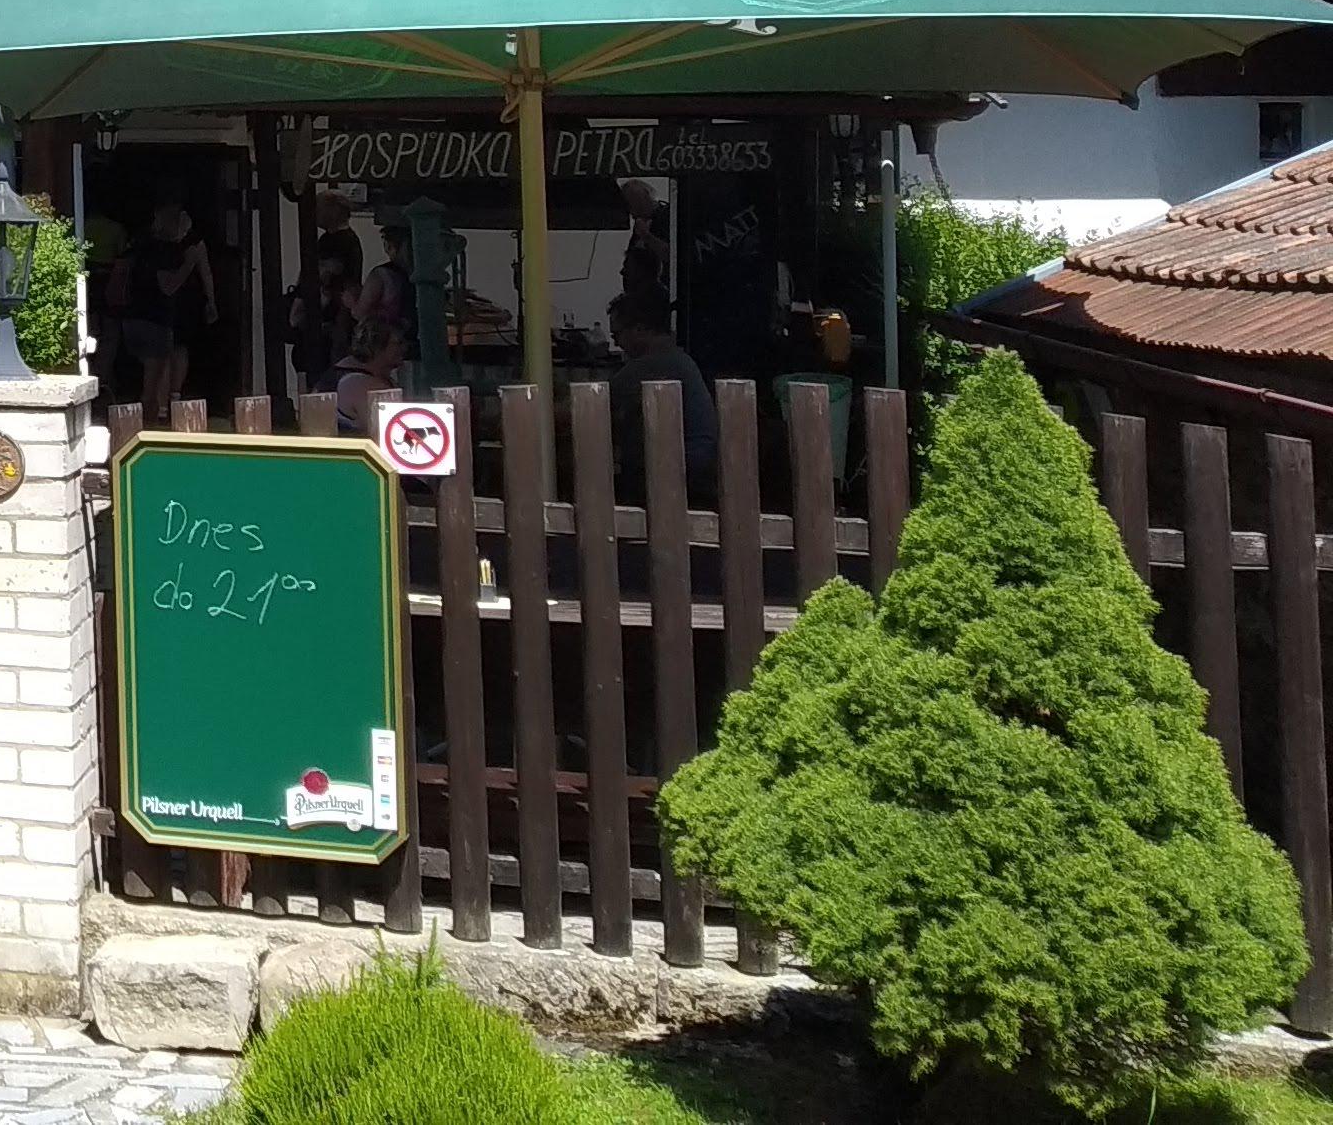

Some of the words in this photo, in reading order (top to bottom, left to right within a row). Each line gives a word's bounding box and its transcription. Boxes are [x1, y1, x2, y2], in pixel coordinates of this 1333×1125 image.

[552, 128, 654, 176] PETRA
[159, 499, 264, 551] Dnes
[153, 562, 193, 611] do
[141, 795, 189, 817] Pilsner
[191, 800, 244, 822] Urquell
[294, 793, 330, 816] Pilsner
[330, 795, 364, 814] Urquell
